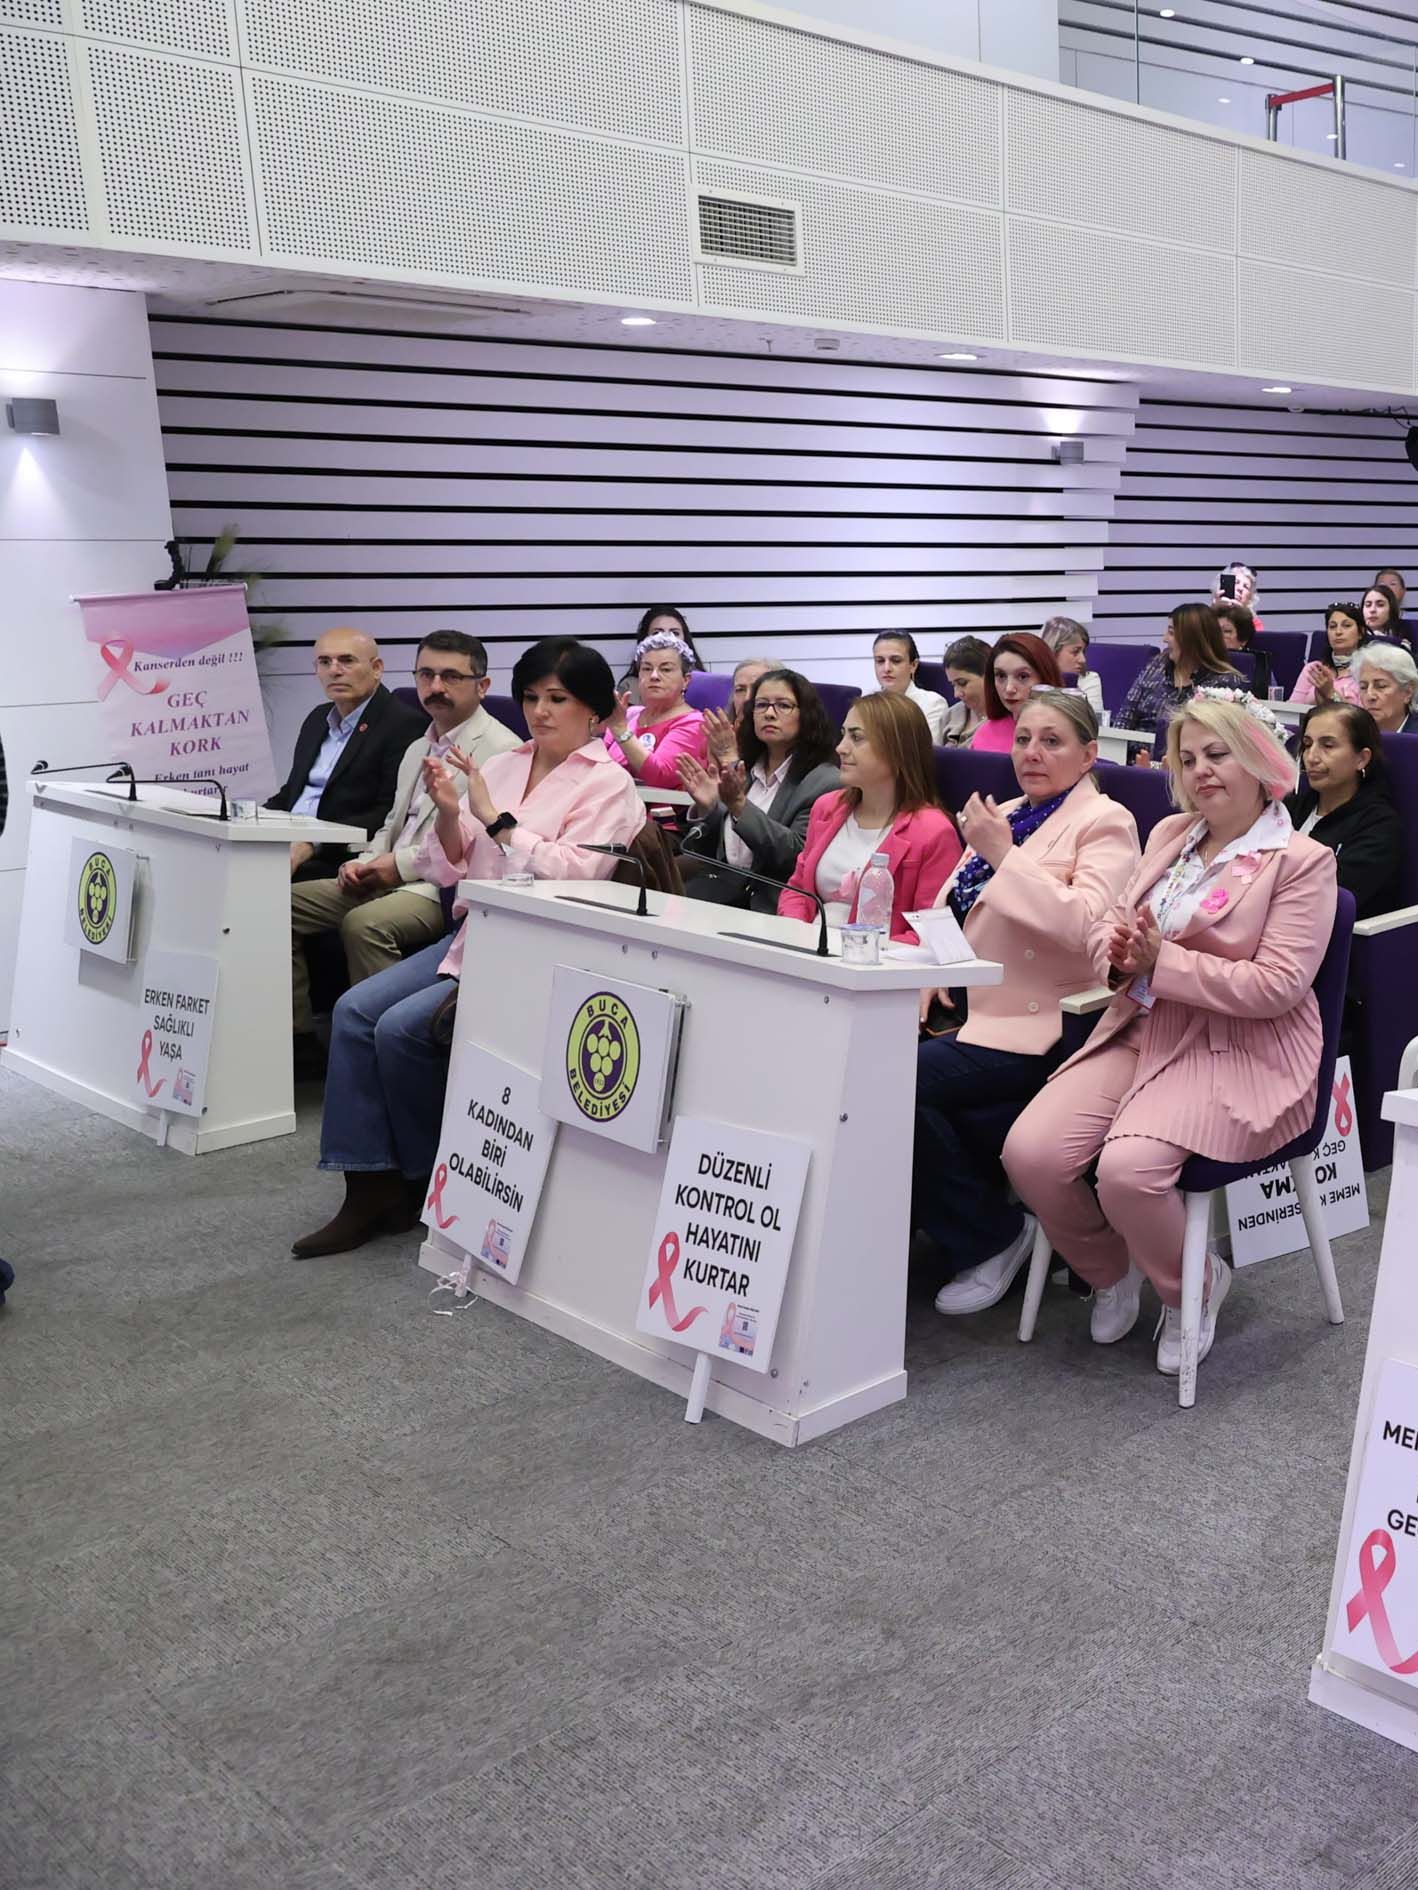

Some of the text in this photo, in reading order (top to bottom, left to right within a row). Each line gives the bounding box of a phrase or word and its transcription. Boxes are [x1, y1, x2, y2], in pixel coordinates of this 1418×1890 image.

[134, 657, 196, 672] Kanserden
[198, 654, 226, 668] değil
[167, 691, 208, 708] GEÇ
[130, 710, 250, 737] KALMAKTAN
[169, 736, 222, 756] KORK
[219, 763, 249, 776] hayat
[144, 988, 210, 1015] ERKEN FARKET
[587, 999, 628, 1029] BUCA
[153, 1014, 194, 1037] SAĞLIKLI
[159, 1040, 182, 1062] YAŞA
[501, 1086, 511, 1105] 8
[569, 1068, 630, 1117] BELEDİYESİ
[467, 1098, 534, 1152] KADINDAN
[481, 1139, 507, 1168] BİRİ
[1323, 1139, 1346, 1157] GEÇ
[449, 1152, 524, 1213] OLABİLİRSİN
[698, 1152, 772, 1191] DÜZENLİ
[1330, 1183, 1360, 1203] MEME
[674, 1185, 782, 1232] KONTROL OL
[685, 1222, 761, 1263] HAYATINI
[683, 1258, 750, 1298] KURTAR
